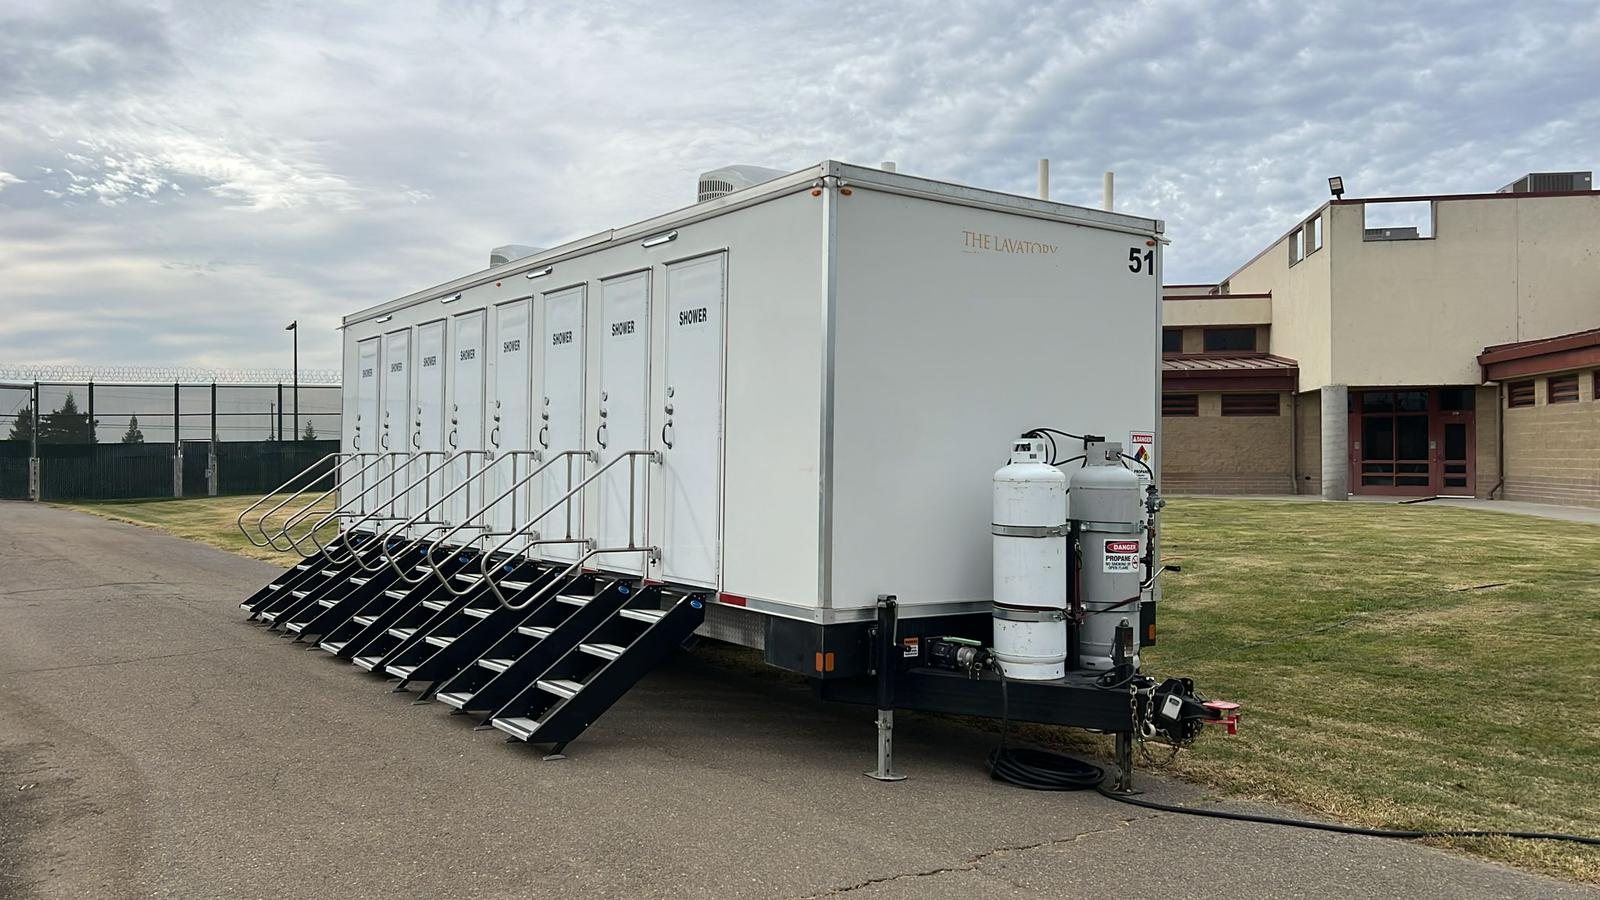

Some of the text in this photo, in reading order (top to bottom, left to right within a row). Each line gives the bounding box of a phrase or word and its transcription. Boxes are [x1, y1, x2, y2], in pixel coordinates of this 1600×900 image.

[961, 230, 991, 250] THE
[1128, 247, 1154, 275] 51
[679, 307, 708, 326] SHOWER
[611, 320, 635, 337] SHOWER
[552, 330, 573, 346] SHOWER
[503, 339, 521, 353] SHOWER
[423, 355, 437, 368] SHOWER
[460, 348, 475, 361] SHOWER
[362, 368, 373, 379] SHOWER
[390, 362, 403, 373] SHOWER
